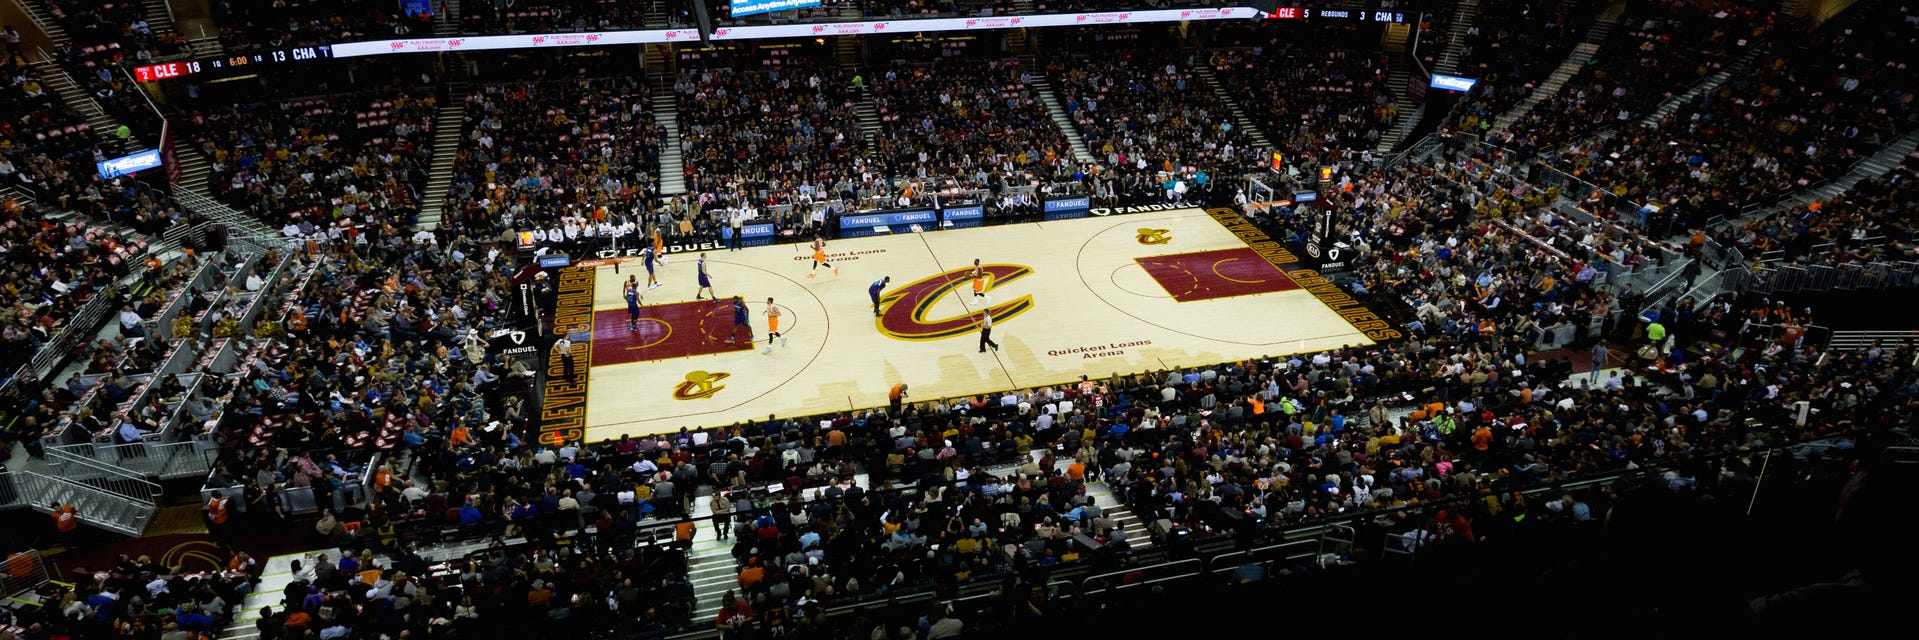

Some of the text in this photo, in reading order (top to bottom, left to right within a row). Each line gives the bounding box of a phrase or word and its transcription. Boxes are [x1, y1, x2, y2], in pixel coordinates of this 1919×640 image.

[757, 1, 786, 11] Anytime
[1279, 8, 1295, 18] CLE
[1303, 9, 1309, 18] 5
[1360, 12, 1366, 21] 3
[1375, 12, 1392, 22] CHA
[154, 65, 179, 78] CLE
[186, 61, 200, 74] 18
[229, 56, 247, 66] 6:00
[254, 54, 262, 62] 18
[272, 50, 285, 62] 13
[293, 47, 316, 60] CHA
[142, 71, 149, 80] 2
[1114, 201, 1200, 214] FANDUEL
[902, 213, 931, 221] FANDUEL
[952, 209, 980, 217] FANDUEL
[851, 217, 881, 225] FANDUEL
[741, 226, 770, 235] ANDUEL
[1207, 207, 1402, 341] CLEVELAND CAVALIERS
[553, 264, 595, 335] CAVALIERS
[503, 346, 537, 354] FANDUEL
[1047, 339, 1152, 356] Quicken Loans
[1083, 350, 1125, 359] Arena
[538, 342, 588, 445] CLEVELAND
